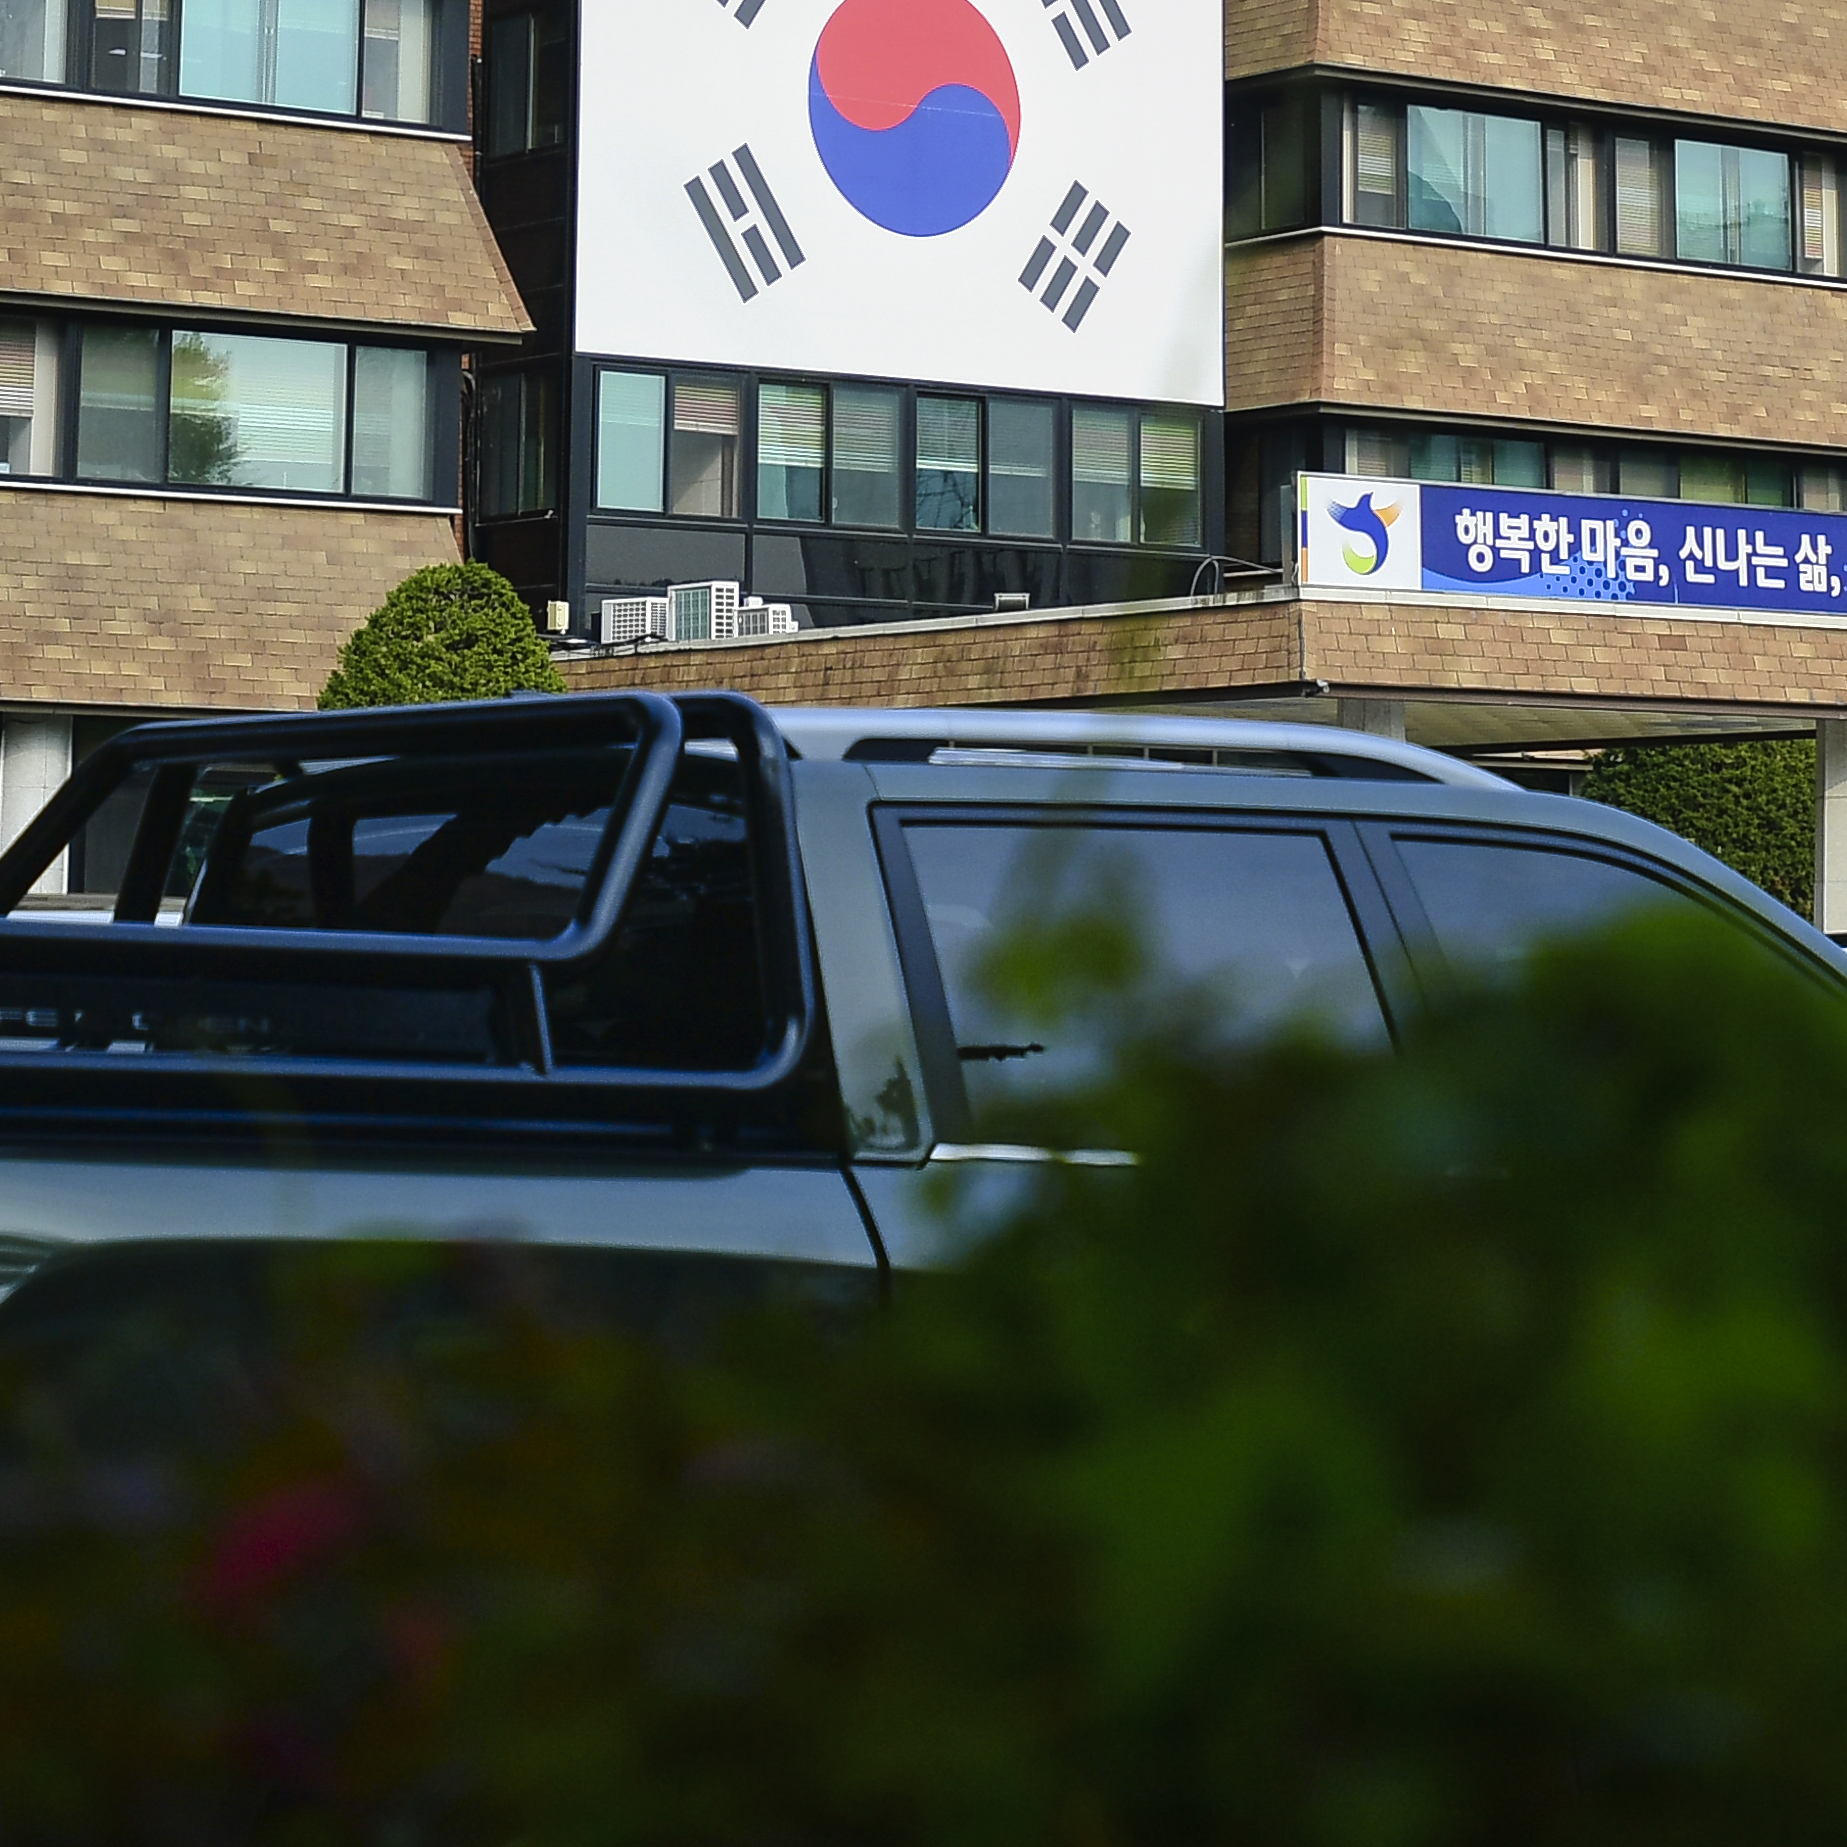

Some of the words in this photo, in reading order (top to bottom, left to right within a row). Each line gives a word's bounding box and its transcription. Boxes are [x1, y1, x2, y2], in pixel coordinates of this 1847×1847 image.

[1454, 507, 1575, 575] 행복한
[1580, 517, 1670, 587] 마음,
[1678, 525, 1789, 589] 신나는
[1794, 533, 1841, 597] 삶,
